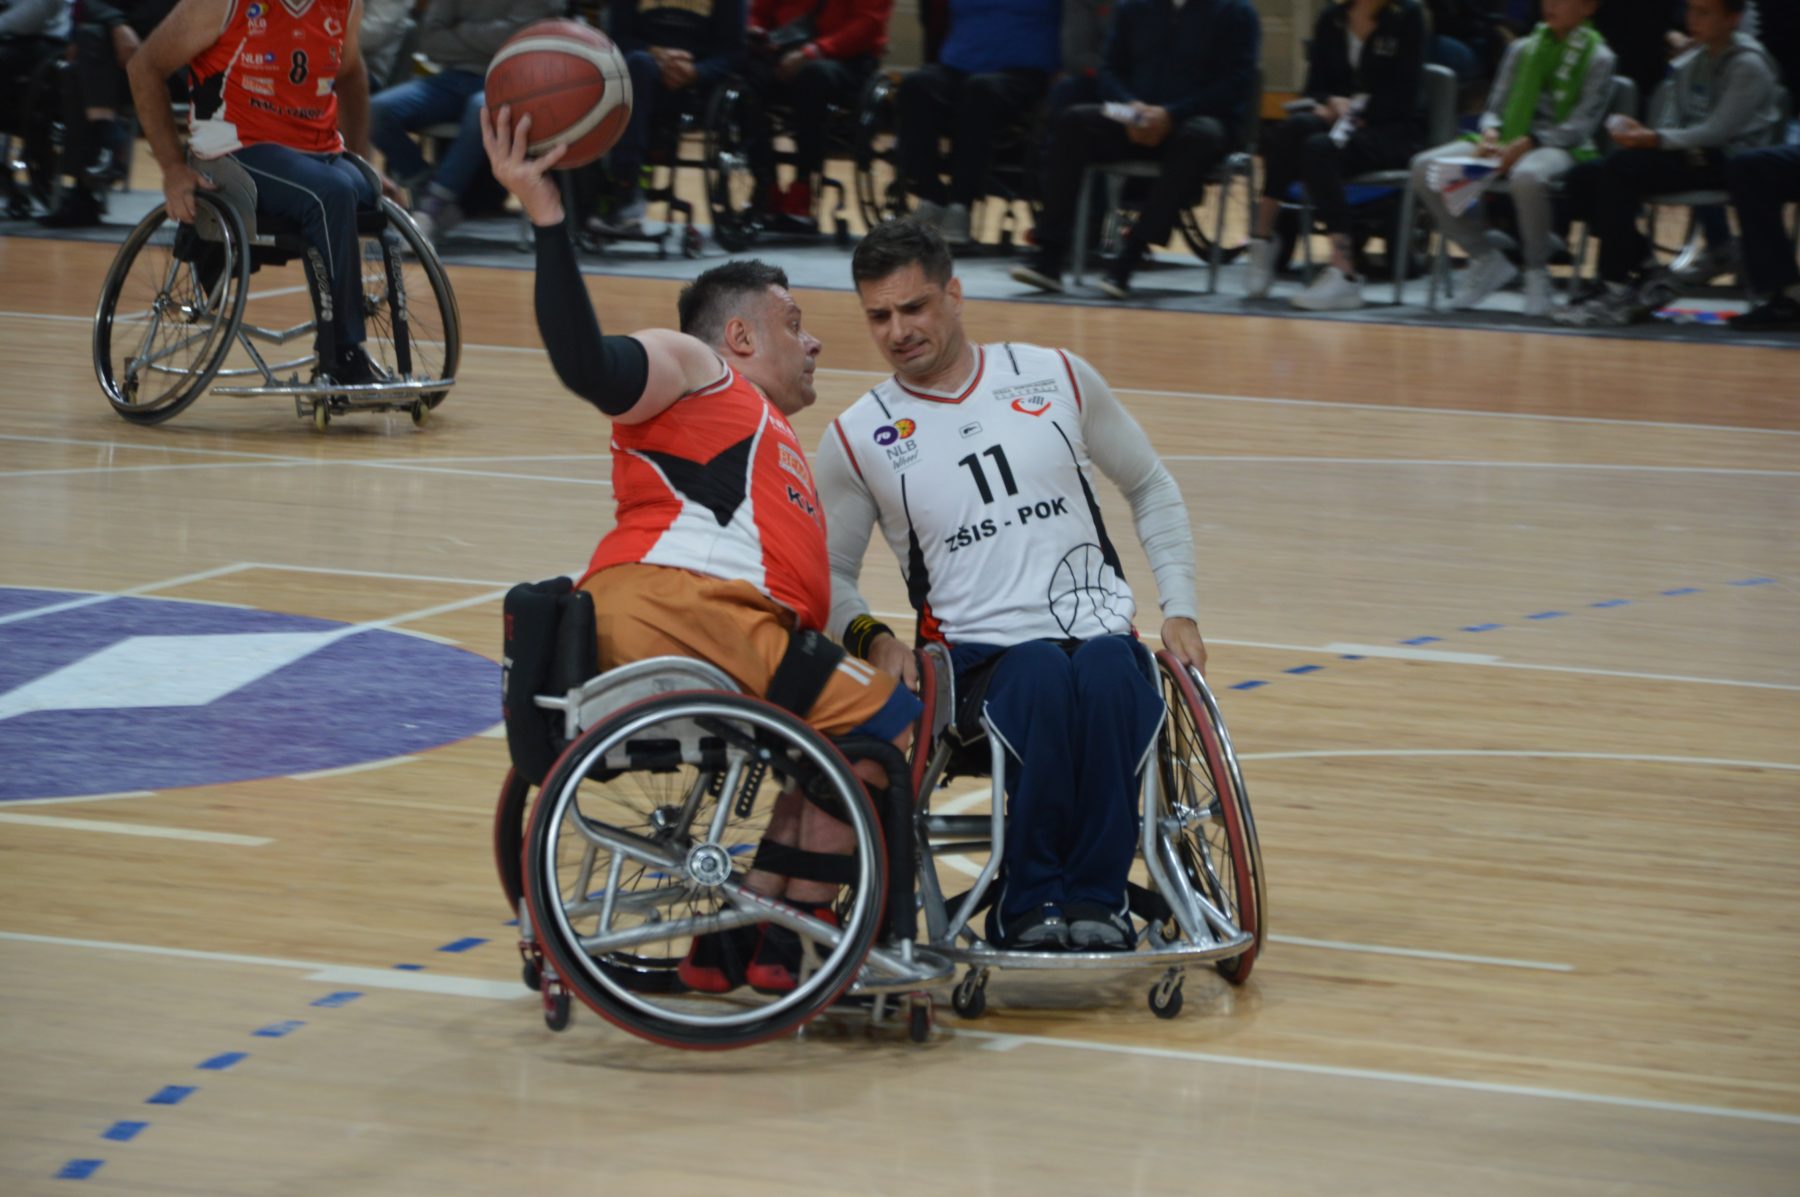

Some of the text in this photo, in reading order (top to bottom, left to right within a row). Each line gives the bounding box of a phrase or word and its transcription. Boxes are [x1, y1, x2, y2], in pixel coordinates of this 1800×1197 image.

[240, 52, 265, 64] NLB
[288, 50, 309, 84] 8
[886, 439, 918, 461] NLB
[957, 443, 1019, 505] 11
[944, 518, 998, 553] ZŠIS
[1017, 497, 1069, 525] POK
